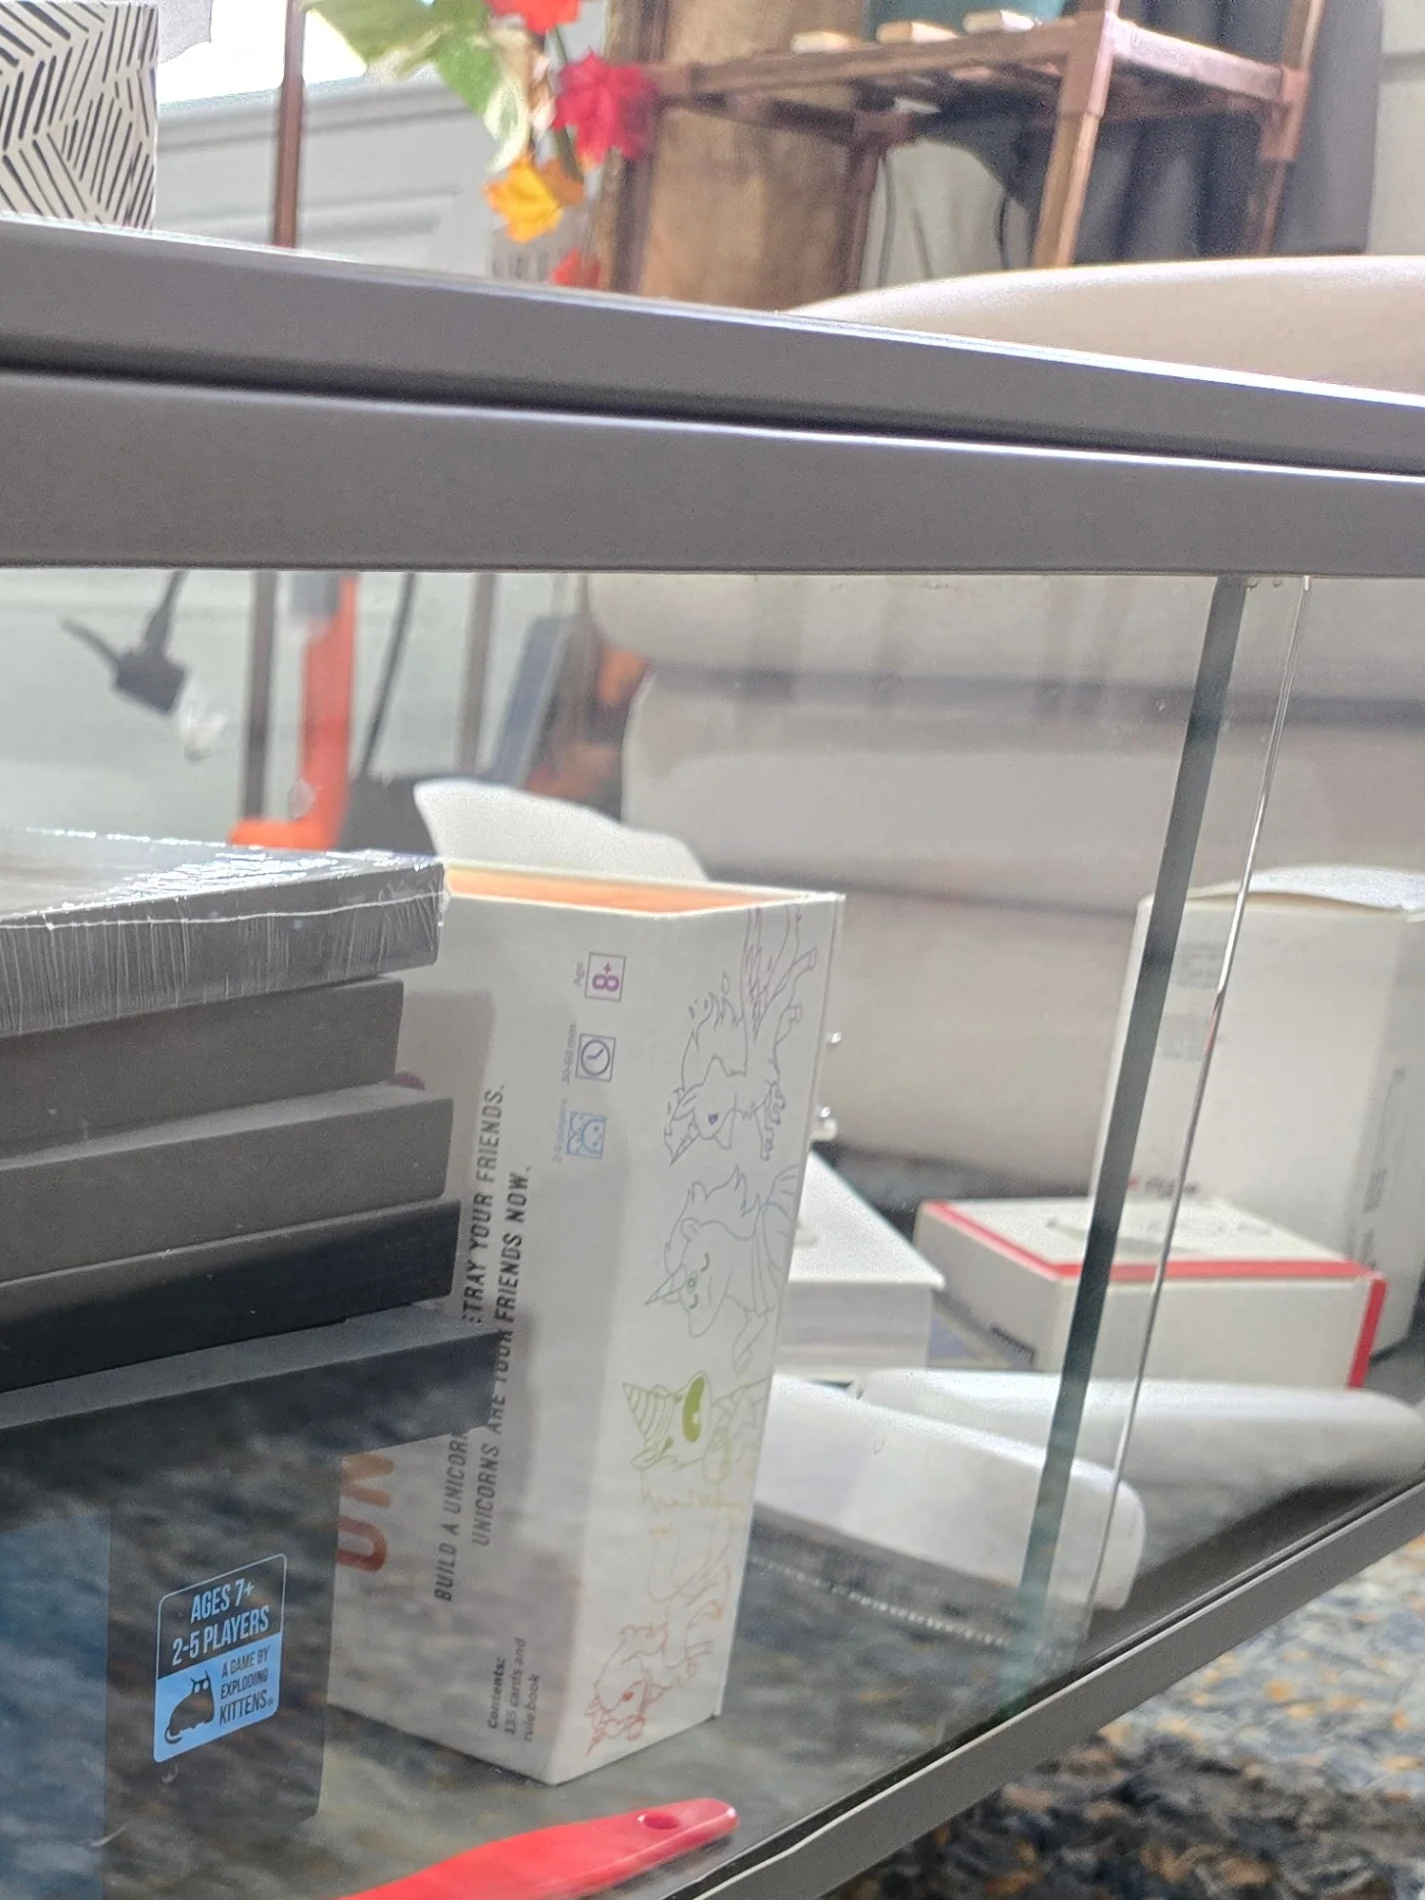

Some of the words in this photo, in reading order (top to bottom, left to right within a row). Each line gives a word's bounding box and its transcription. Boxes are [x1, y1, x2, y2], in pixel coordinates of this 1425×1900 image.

[592, 961, 620, 992] 8+
[476, 1083, 505, 1183] FRIENDS.
[468, 1192, 493, 1251] YOUR
[462, 1259, 488, 1324] TRAY
[472, 1443, 501, 1548] UNICORNS
[493, 1231, 522, 1323] FRIENDS
[441, 1522, 460, 1537] A
[190, 1582, 231, 1623] AGES
[234, 1577, 255, 1607] 7+
[434, 1541, 458, 1602] BUILD
[172, 1629, 200, 1667] 2-5
[203, 1605, 270, 1654] PLAYERS
[221, 1661, 228, 1678] A
[230, 1651, 256, 1675] GAME
[257, 1644, 271, 1665] BY
[220, 1667, 268, 1700] EXPLODING
